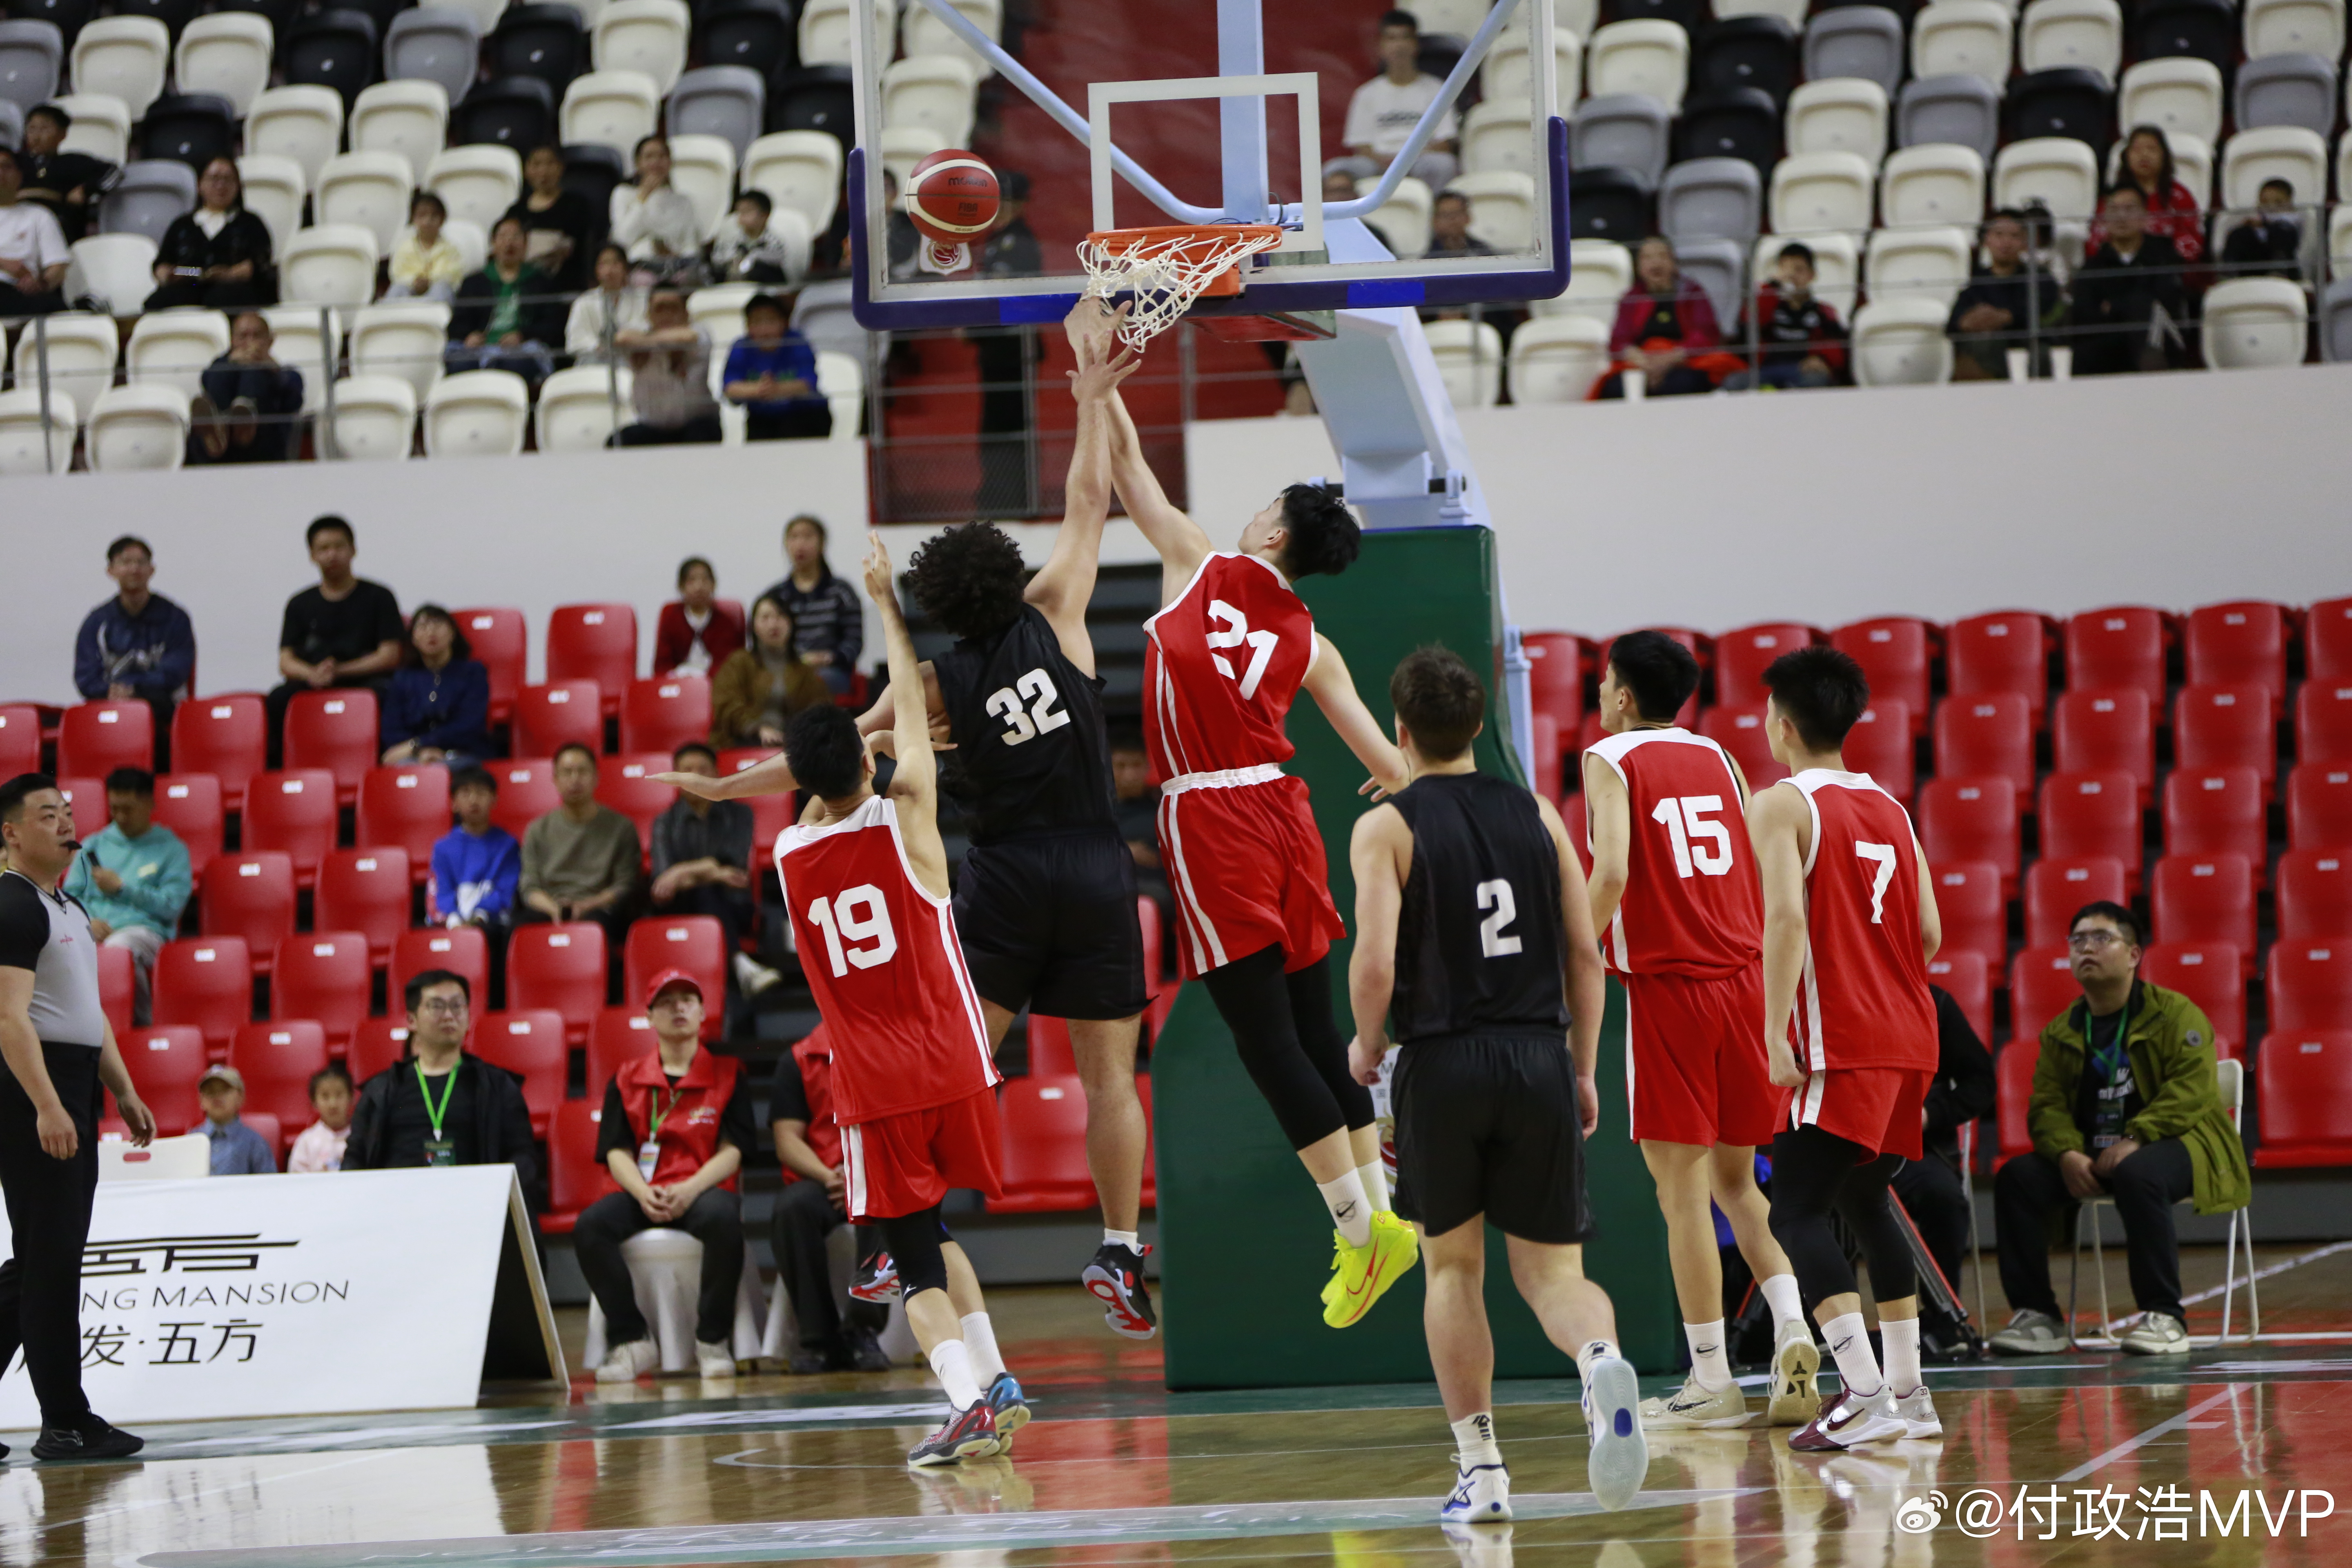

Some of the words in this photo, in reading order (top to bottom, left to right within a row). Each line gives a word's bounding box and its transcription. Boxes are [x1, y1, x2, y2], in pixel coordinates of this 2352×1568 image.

[1205, 599, 1279, 700] 21
[986, 668, 1070, 746] 32
[1652, 795, 1733, 878] 15
[1477, 878, 1523, 958] 2
[1855, 840, 1896, 924] 7
[808, 884, 898, 978] 19
[82, 1288, 139, 1312] NG
[153, 1280, 349, 1307] MANSION
